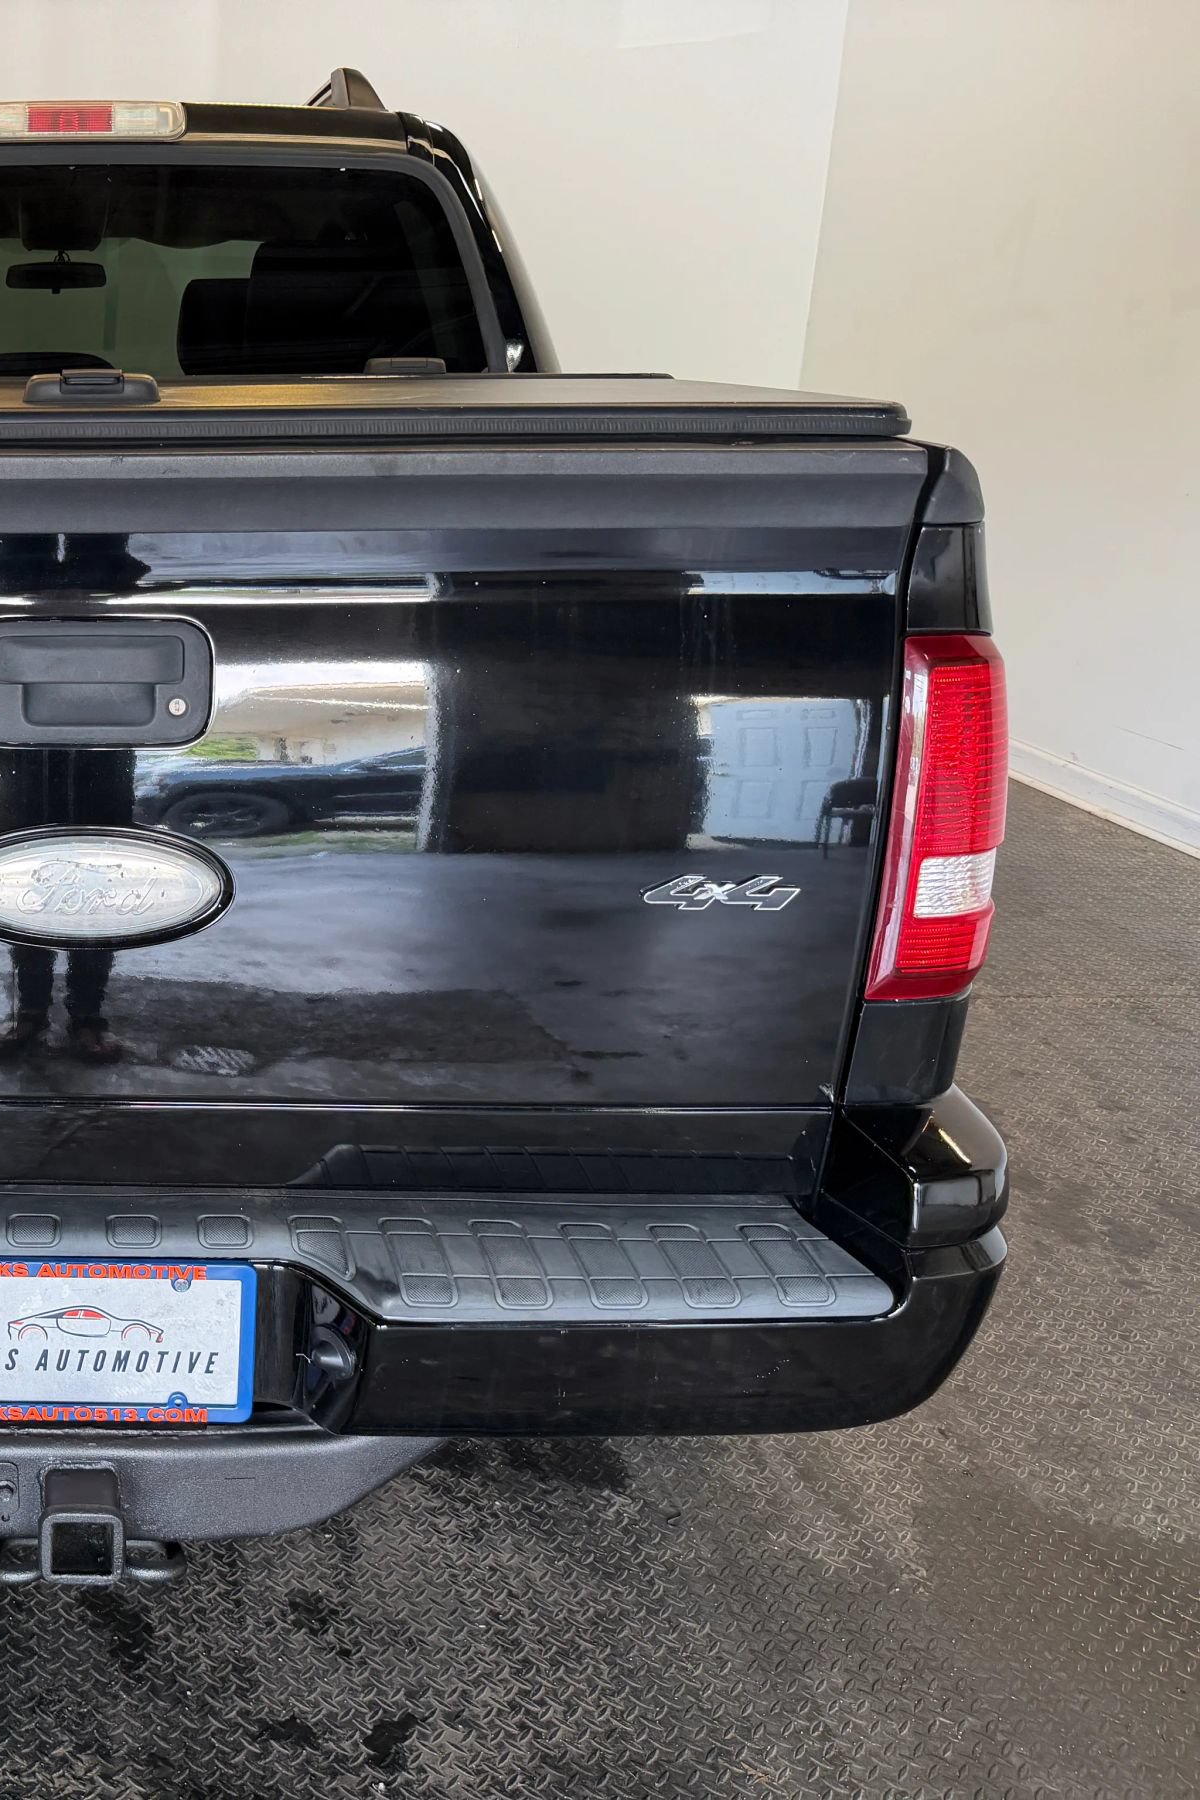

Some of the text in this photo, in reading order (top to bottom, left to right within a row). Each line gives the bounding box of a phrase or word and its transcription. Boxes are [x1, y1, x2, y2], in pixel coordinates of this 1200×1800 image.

[16, 859, 158, 915] Ford
[37, 1263, 208, 1281] AUTOMOTIVE
[35, 1348, 220, 1375] AUTOMOTIVE
